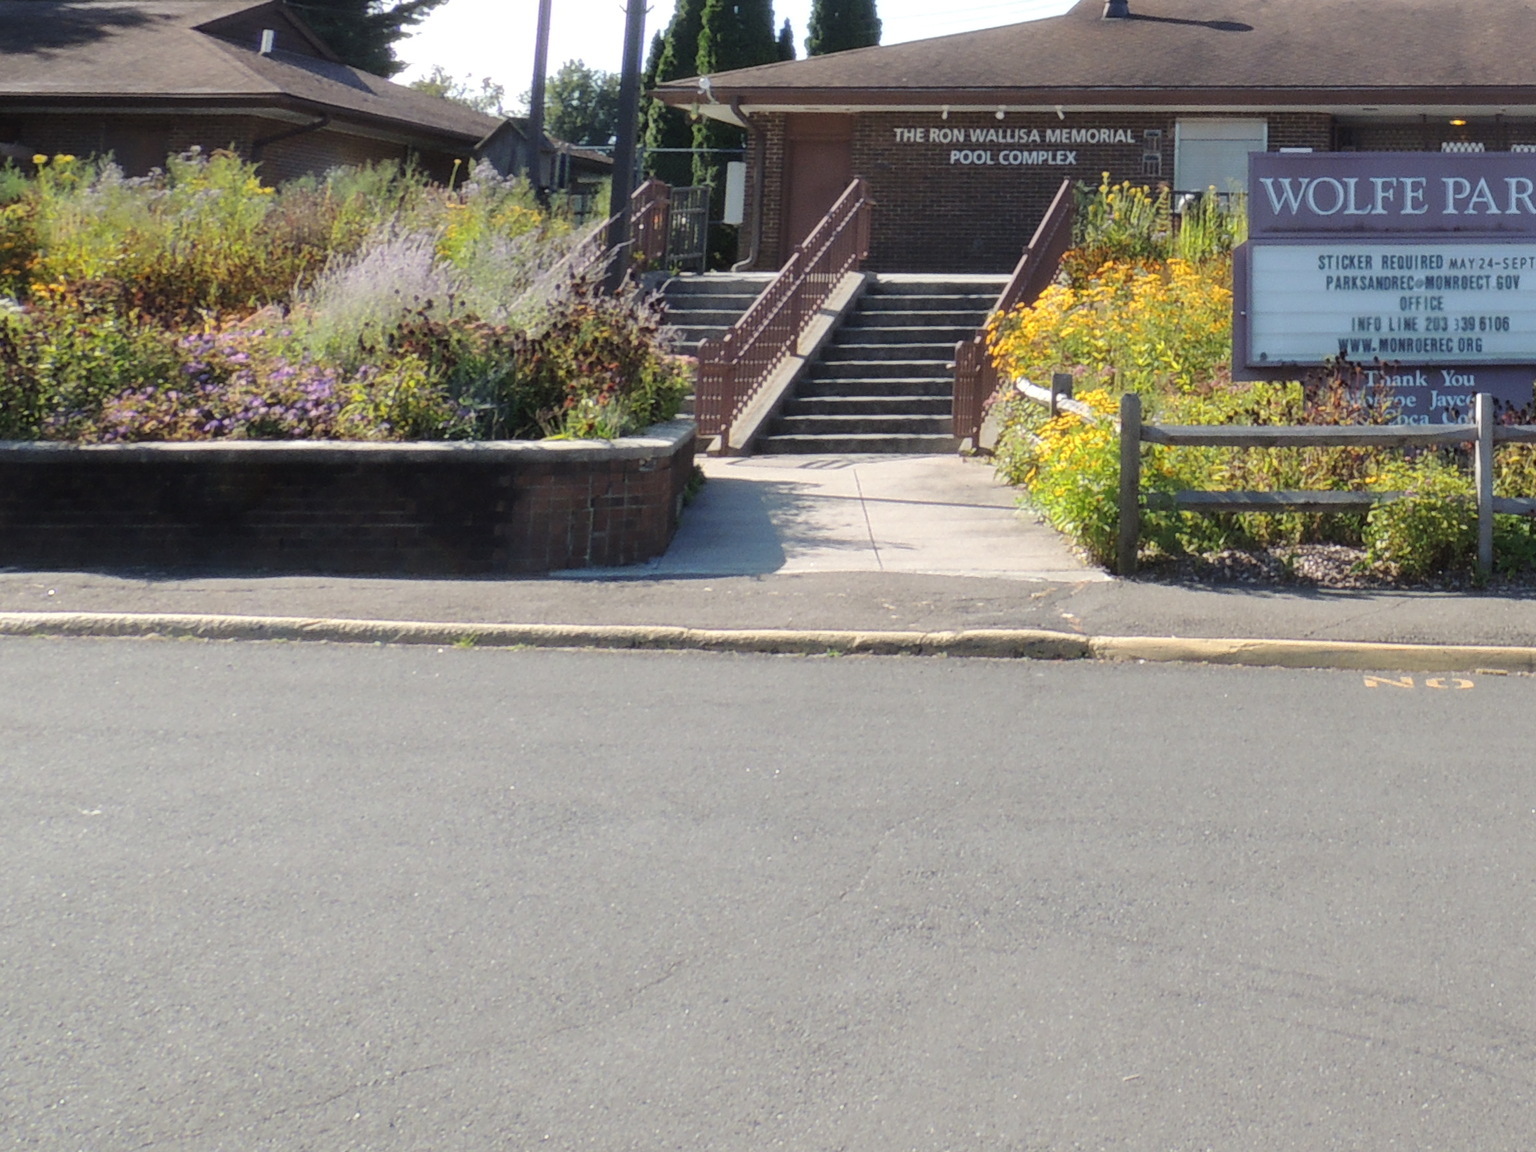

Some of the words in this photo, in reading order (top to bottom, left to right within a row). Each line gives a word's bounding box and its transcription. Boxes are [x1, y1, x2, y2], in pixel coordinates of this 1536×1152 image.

[894, 128, 924, 143] THE
[929, 128, 965, 143] RON
[970, 128, 1041, 144] WALLISA
[1045, 128, 1136, 144] MEMORIAL
[950, 150, 993, 166] POOL
[999, 150, 1077, 166] COMPLEX
[1259, 177, 1428, 215] WOLFE
[1318, 255, 1373, 270] STICKER
[1381, 255, 1444, 270] REQUIRED
[1448, 257, 1475, 270] MAY
[1400, 296, 1444, 311] OFFICE
[1352, 316, 1382, 332] INFO
[1388, 316, 1418, 332] LINE
[1425, 316, 1448, 332] 203
[1479, 316, 1510, 332] 6106
[1440, 369, 1475, 387] You
[1362, 676, 1475, 689] NO
